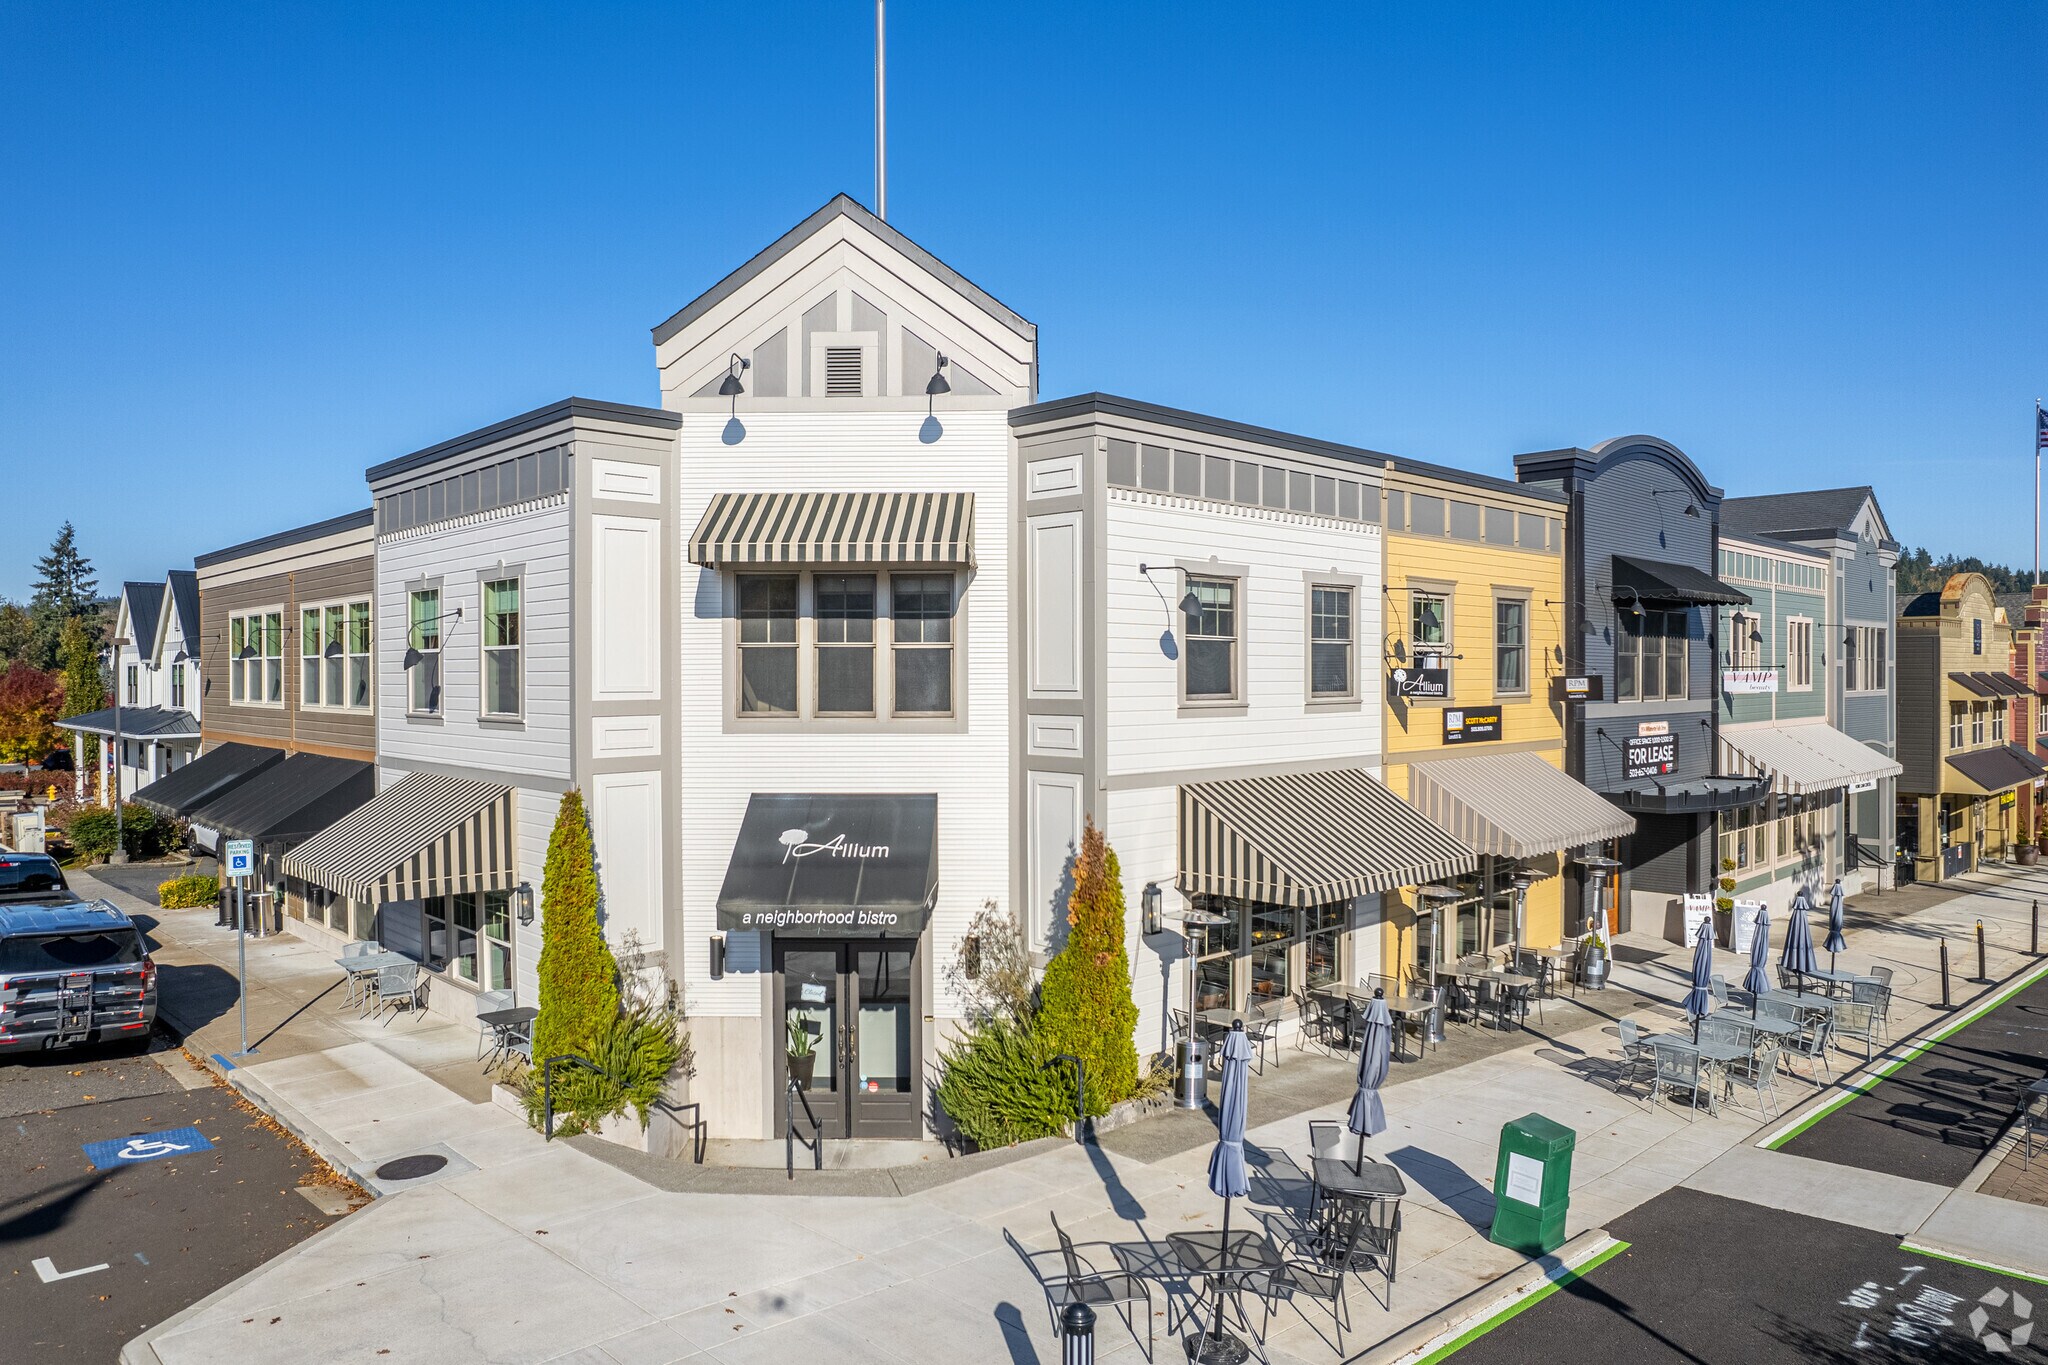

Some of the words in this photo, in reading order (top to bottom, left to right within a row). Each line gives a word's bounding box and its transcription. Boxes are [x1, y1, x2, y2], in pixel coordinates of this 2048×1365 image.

[1402, 673, 1444, 692] Allium
[1568, 679, 1586, 687] RPM
[1732, 672, 1772, 683] VAMP
[1448, 713, 1461, 724] RPM
[1629, 738, 1642, 746] OFFICE
[1641, 737, 1652, 745] SPACE
[1629, 748, 1647, 766] FOR
[1648, 745, 1674, 763] LEASE
[792, 833, 890, 859] Allium
[742, 912, 752, 924] a
[755, 910, 855, 927] neighborhood
[857, 910, 898, 925] bistro
